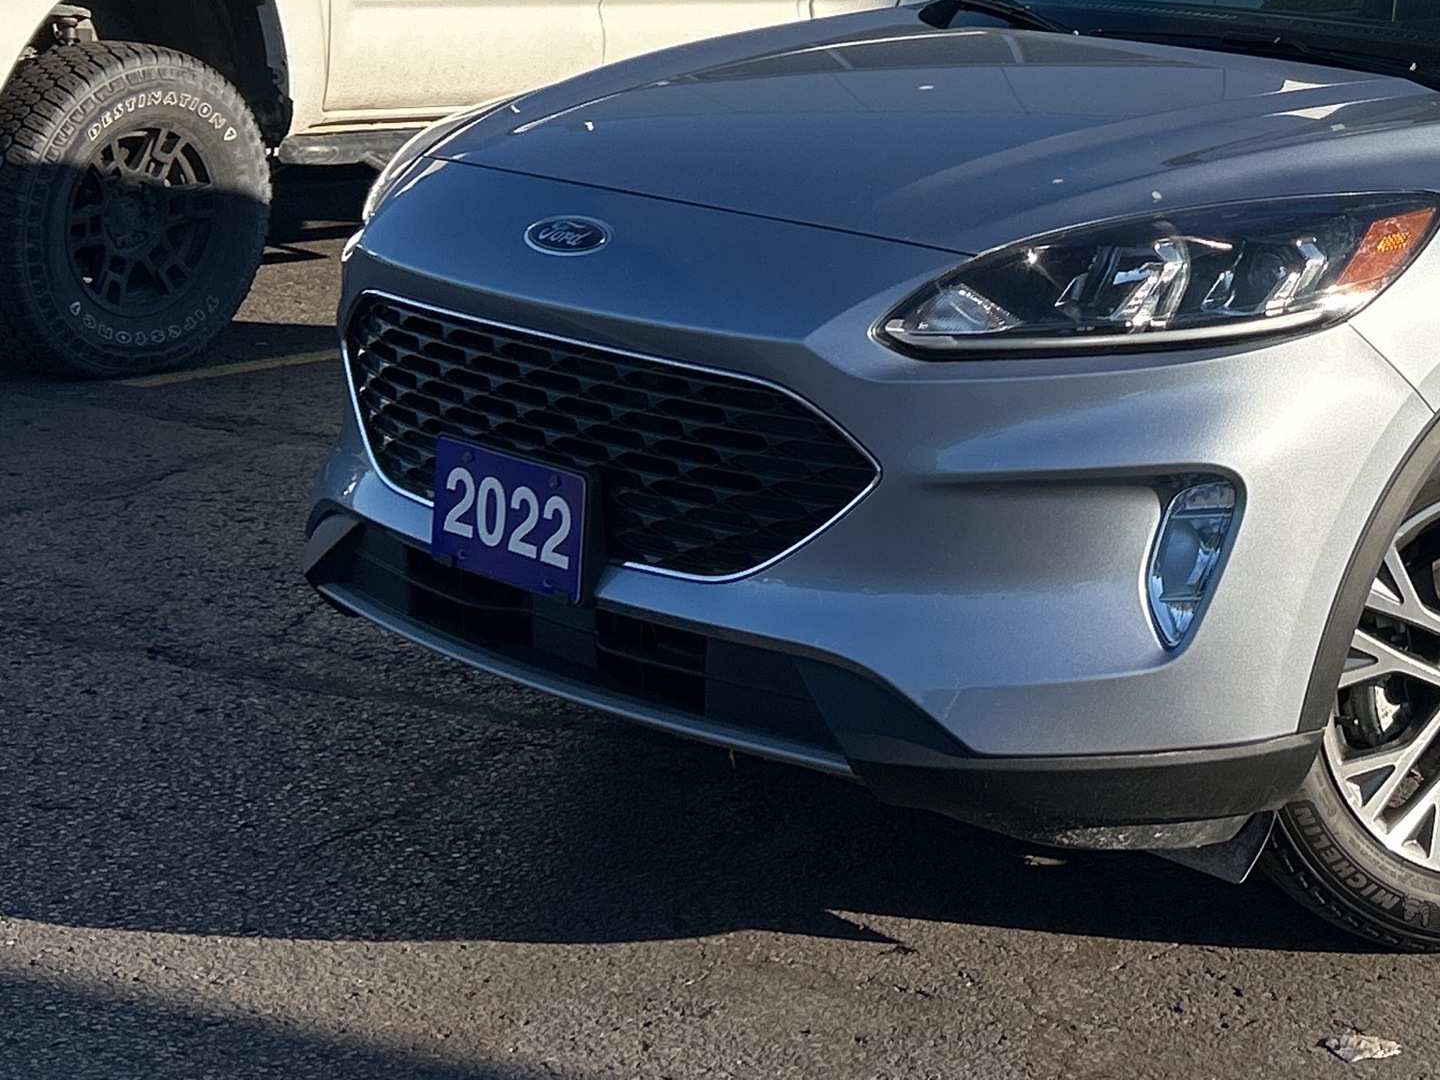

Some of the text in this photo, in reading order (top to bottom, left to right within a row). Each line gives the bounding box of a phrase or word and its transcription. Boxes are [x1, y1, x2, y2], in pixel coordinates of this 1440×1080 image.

[87, 91, 226, 141] DESTINATION
[538, 220, 593, 246] Ford
[443, 467, 571, 570] 2022
[1293, 806, 1401, 911] MICHELIN
